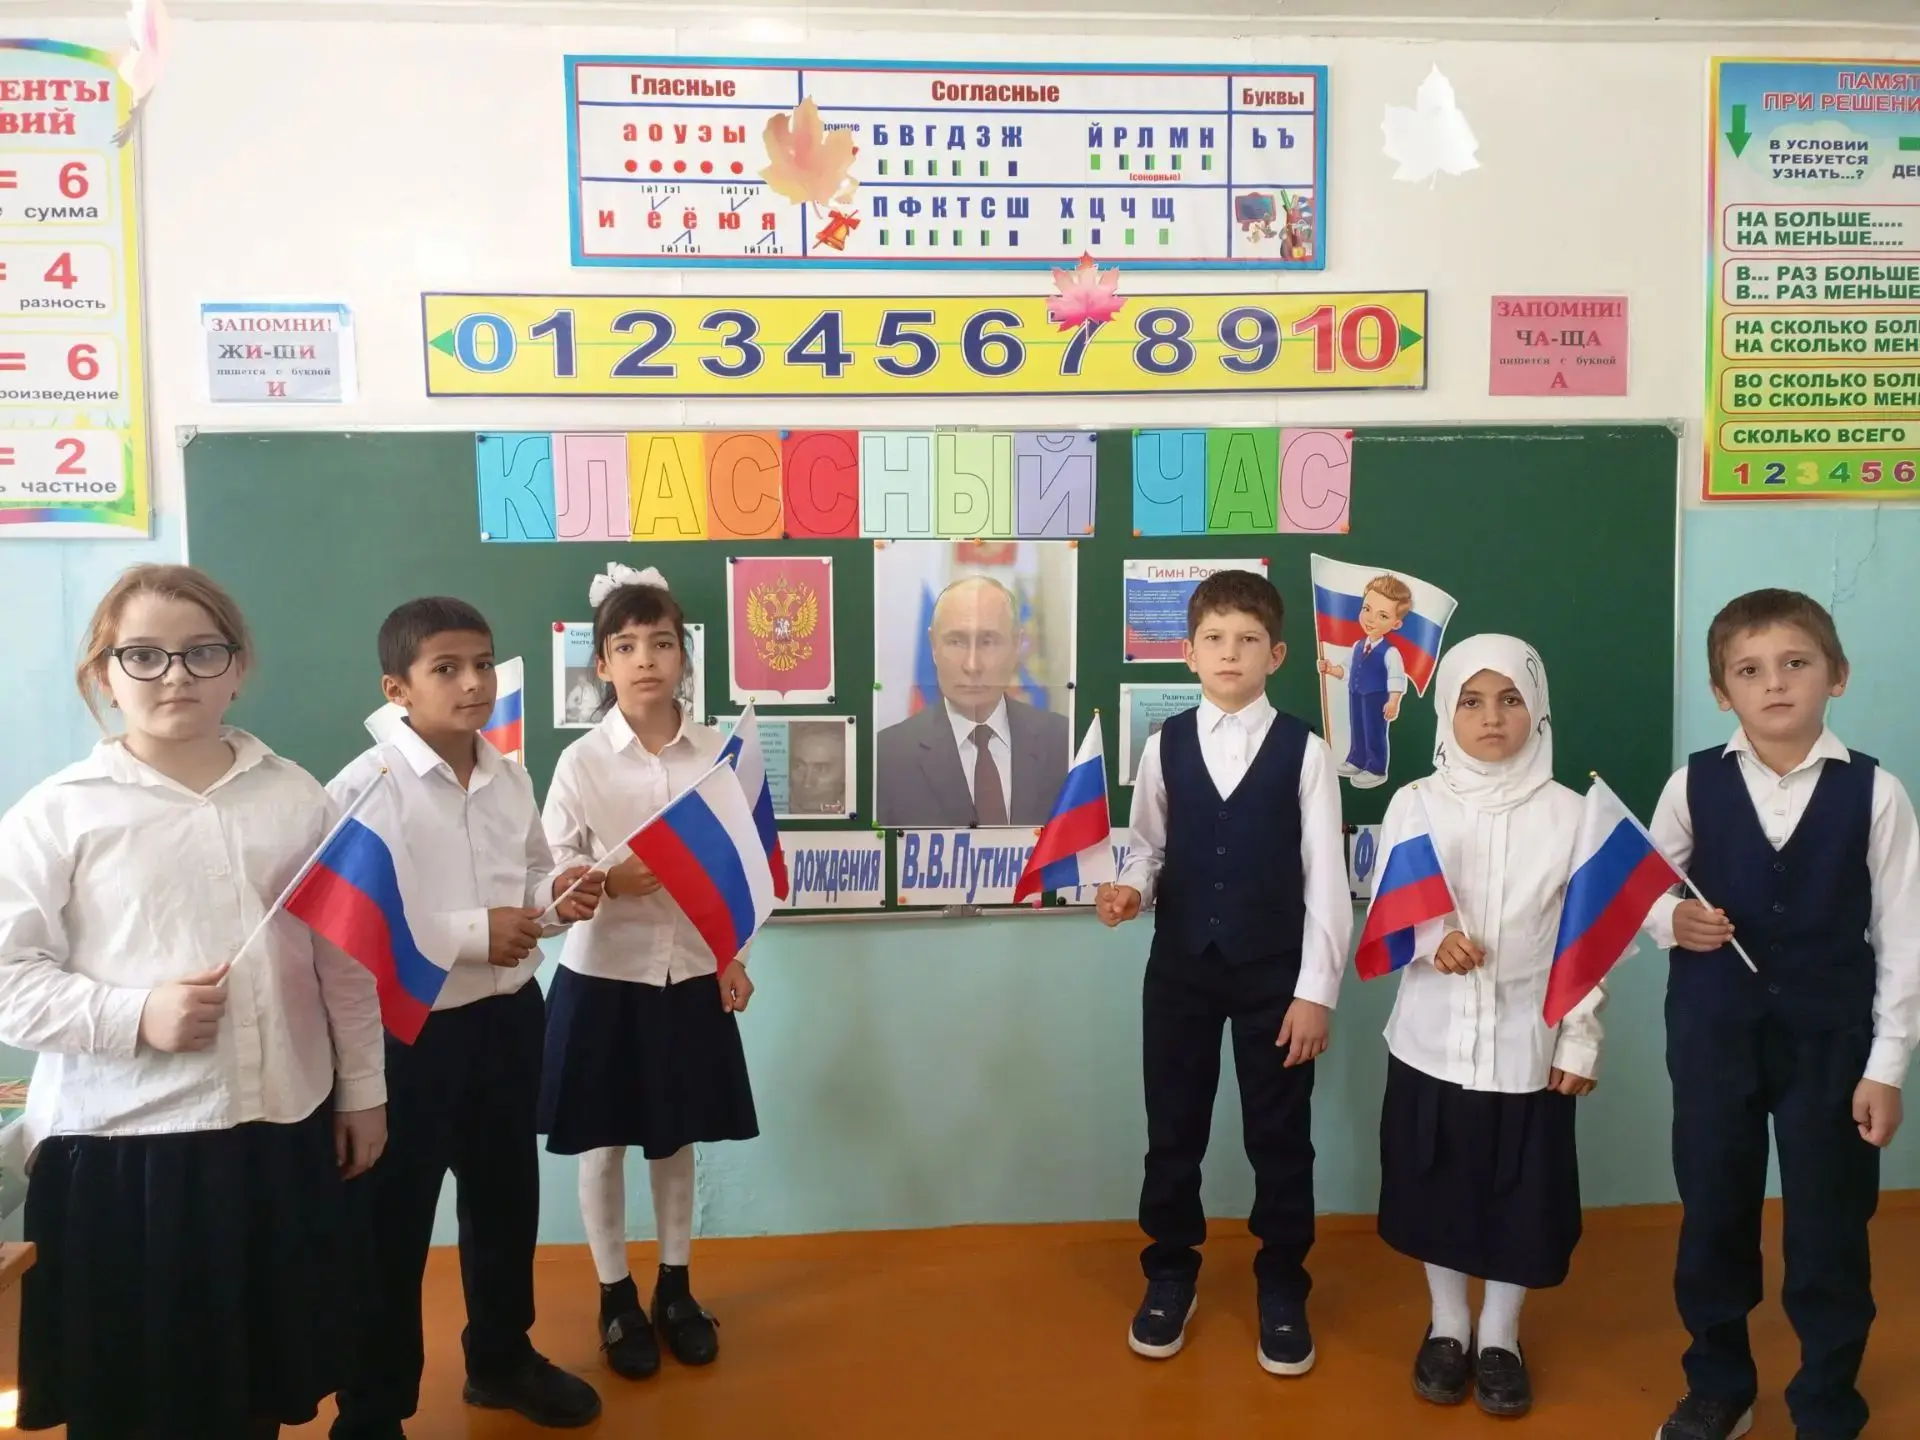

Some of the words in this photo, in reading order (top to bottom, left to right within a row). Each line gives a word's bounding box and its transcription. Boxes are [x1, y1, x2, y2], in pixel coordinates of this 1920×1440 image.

[1, 79, 110, 102] ЕНТЫ
[630, 74, 736, 97] Гласные
[931, 80, 1059, 103] Согласные
[1242, 88, 1305, 106] Буквы
[1763, 92, 1814, 112] ПРИ
[0, 106, 76, 135] ВИЙ
[623, 123, 638, 142] а
[648, 123, 663, 142] о
[673, 124, 688, 144] у
[698, 125, 713, 143] э
[723, 126, 746, 144] ы
[873, 124, 889, 146] Б
[899, 124, 915, 146] В
[925, 125, 937, 147] Г
[947, 125, 966, 150] Д
[976, 125, 991, 147] З
[1001, 126, 1023, 148] Ж
[1088, 122, 1103, 148] Й
[1113, 127, 1128, 148] Р
[1137, 127, 1154, 148] Л
[1169, 127, 1189, 148] М
[1199, 127, 1215, 148] Н
[1252, 128, 1267, 149] Ь
[1277, 128, 1295, 149] Ъ
[1769, 140, 1780, 150] В
[1787, 140, 1869, 151] УСЛОВИИ
[1769, 154, 1868, 165] ТРЕБУЕТСЯ
[59, 161, 89, 199] 6
[1892, 164, 1920, 179] ДЕ
[24, 206, 99, 222] сумма
[873, 196, 888, 218] П
[898, 196, 922, 218] Ф
[932, 196, 947, 218] К
[957, 196, 971, 218] Т
[981, 196, 996, 218] С
[1007, 197, 1029, 218] Ш
[1060, 197, 1075, 218] Х
[1089, 197, 1106, 222] Ц
[1120, 197, 1136, 218] Ч
[1151, 197, 1175, 222] Щ
[599, 210, 615, 228] и
[647, 211, 662, 229] е
[683, 206, 698, 230] ё
[719, 212, 741, 230] ю
[761, 212, 776, 230] я
[1737, 212, 1768, 227] НА
[1737, 231, 1768, 245] НА
[44, 251, 79, 289] 4
[1777, 266, 1817, 281] РАЗ
[1824, 266, 1919, 281] БОЛЬШЕ
[1776, 285, 1817, 299] РАЗ
[1824, 284, 1920, 299] МЕНЬШЕ
[20, 298, 106, 310] разность
[1498, 302, 1621, 317] ЗАПОМНИ!
[212, 318, 332, 332] ЗАПОМНИ!
[1735, 320, 1764, 334] НА
[1770, 320, 1867, 335] СКОЛЬКО
[1875, 320, 1920, 334] БОЛ
[454, 312, 518, 374] 0
[528, 308, 578, 378] 1
[609, 309, 678, 379] 2
[698, 308, 766, 379] 3
[783, 309, 855, 379] 4
[873, 309, 940, 379] 5
[960, 308, 1027, 377] 6
[1046, 309, 1108, 377] 7
[1132, 306, 1197, 376] 8
[1216, 305, 1282, 375] 9
[1291, 304, 1401, 374] 10
[1516, 329, 1602, 348] ЧА-ЩА
[1735, 339, 1763, 352] НА
[1770, 339, 1867, 353] СКОЛЬКО
[218, 344, 316, 359] ЖИ-ШИ
[67, 343, 100, 381] 6
[266, 381, 287, 397] И
[1550, 371, 1569, 389] А
[1734, 374, 1763, 388] ВО
[1769, 374, 1867, 388] СКОЛЬКО
[1874, 373, 1920, 387] БОЛ
[1734, 393, 1762, 407] ВО
[1769, 393, 1867, 407] СКОЛЬКО
[1874, 392, 1920, 406] МЕН
[1733, 430, 1831, 444] СКОЛЬКО
[1837, 428, 1906, 443] ВСЕГО
[55, 437, 87, 475] 2
[1733, 463, 1750, 485] 1
[1764, 463, 1786, 485] 2
[1796, 462, 1818, 484] 3
[1828, 461, 1850, 483] 4
[1861, 461, 1882, 482] 5
[1893, 461, 1915, 483] 6
[21, 481, 117, 494] частное
[478, 433, 1093, 539] КЛАССНЫЙ
[1136, 431, 1349, 534] ЧАС
[1147, 566, 1184, 578] Гимн
[792, 848, 881, 906] рождения
[901, 833, 1036, 904] В.В.Путин
